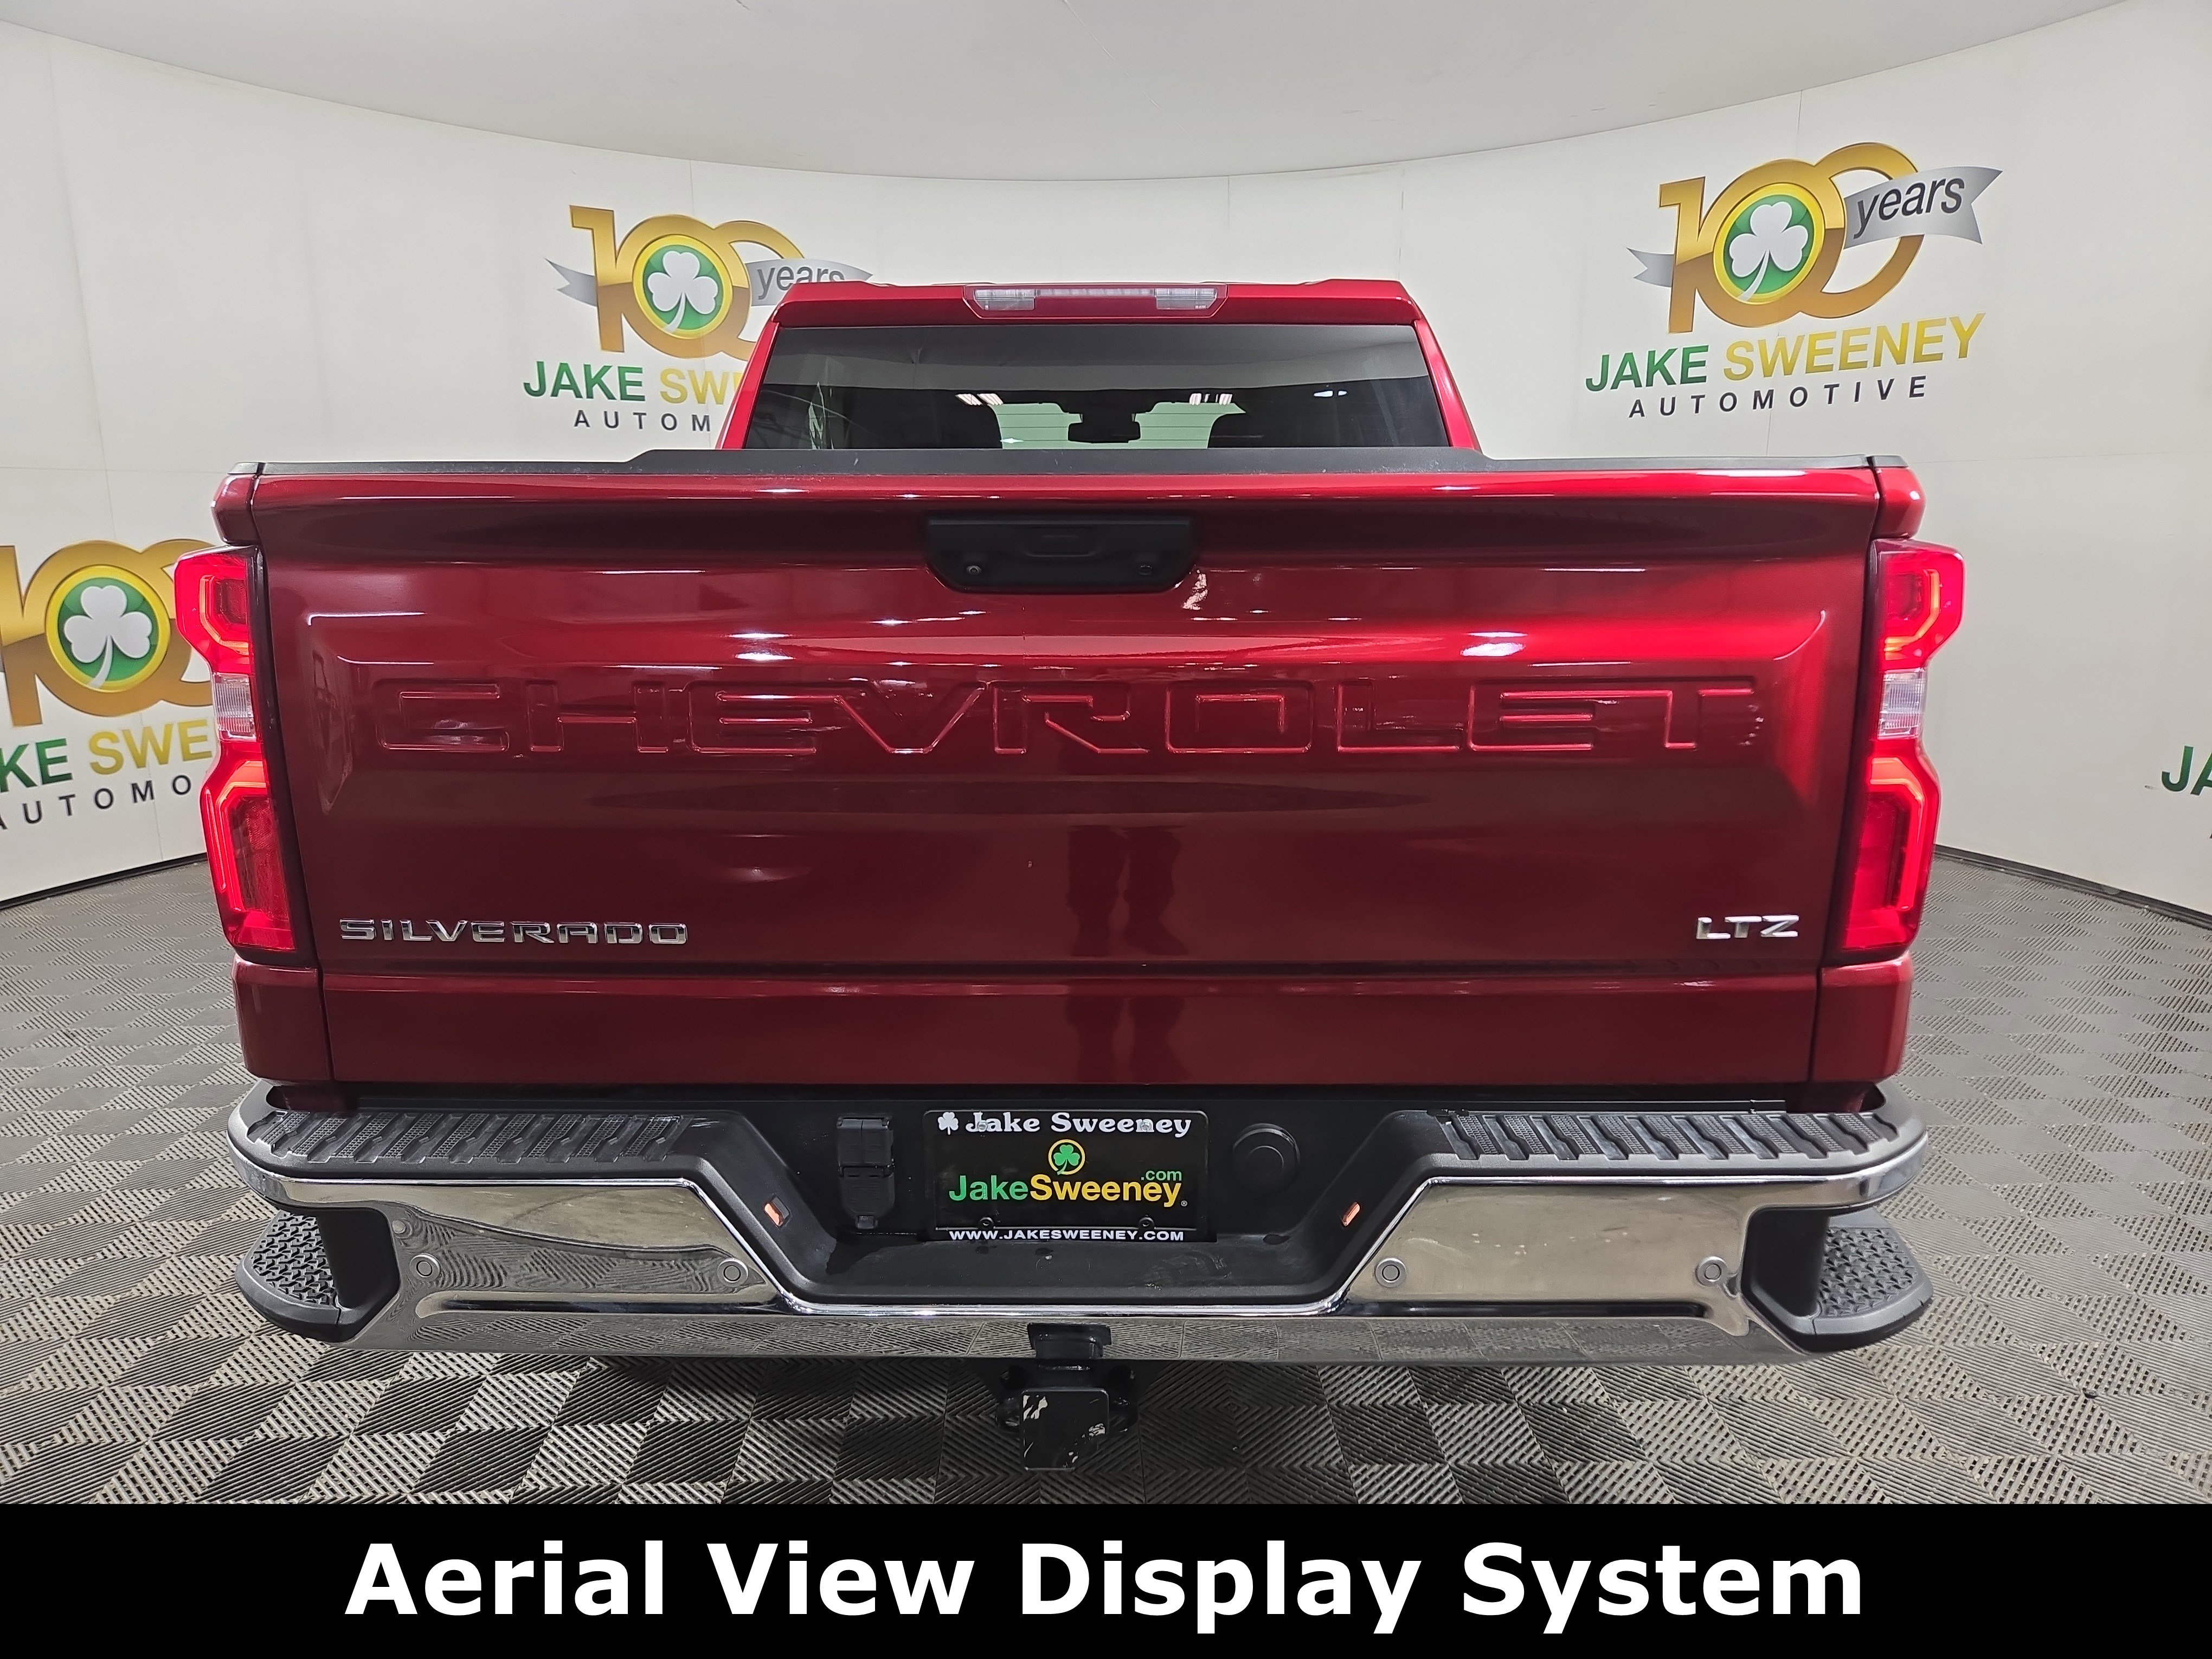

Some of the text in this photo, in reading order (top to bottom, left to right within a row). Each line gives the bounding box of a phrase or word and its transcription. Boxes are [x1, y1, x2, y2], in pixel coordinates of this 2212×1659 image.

[1853, 176, 1965, 239] years
[1585, 312, 1986, 392] JAKE SWEENEY
[523, 361, 743, 404] JAKE SW
[1629, 375, 1927, 418] AUTOMOTIVE
[373, 676, 1758, 756] CHEVROLET
[339, 918, 688, 944] SILVERADO
[1696, 915, 1799, 940] LTZ
[965, 1112, 1192, 1138] Jake Sweeney
[1141, 1170, 1182, 1181] .com
[949, 1229, 1184, 1241] WWW.JAKESWEENEY.COM
